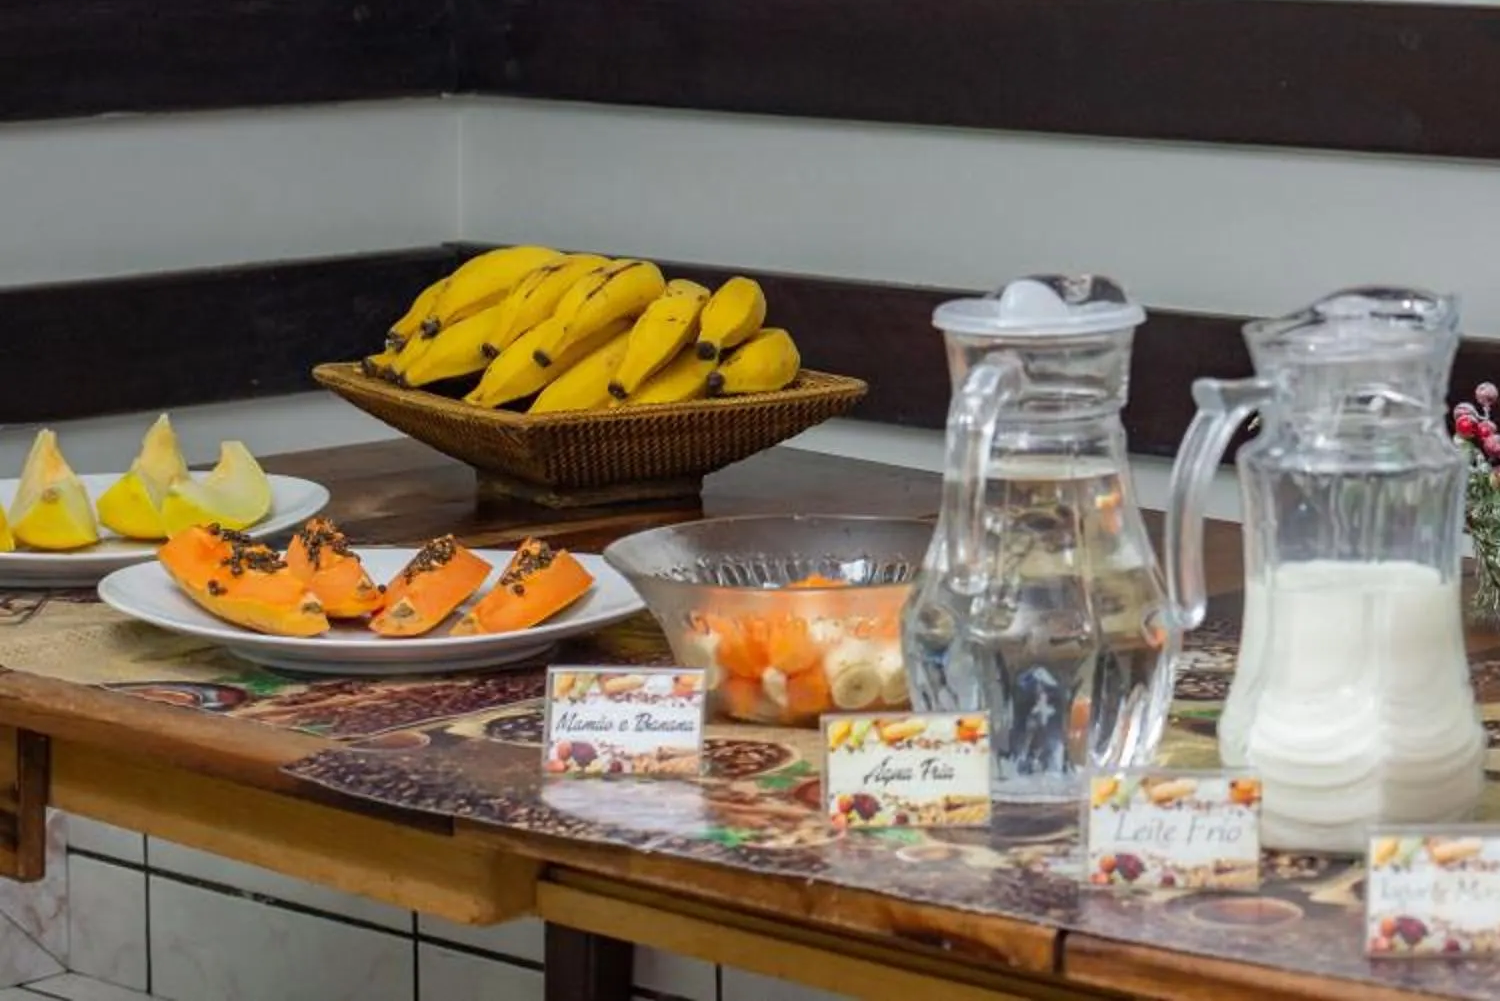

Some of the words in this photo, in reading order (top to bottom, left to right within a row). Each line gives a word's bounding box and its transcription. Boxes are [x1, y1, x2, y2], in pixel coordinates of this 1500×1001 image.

[633, 712, 695, 733] Banana
[920, 757, 956, 781] Fria
[1114, 814, 1177, 843] Leite
[1186, 814, 1243, 846] Frio
